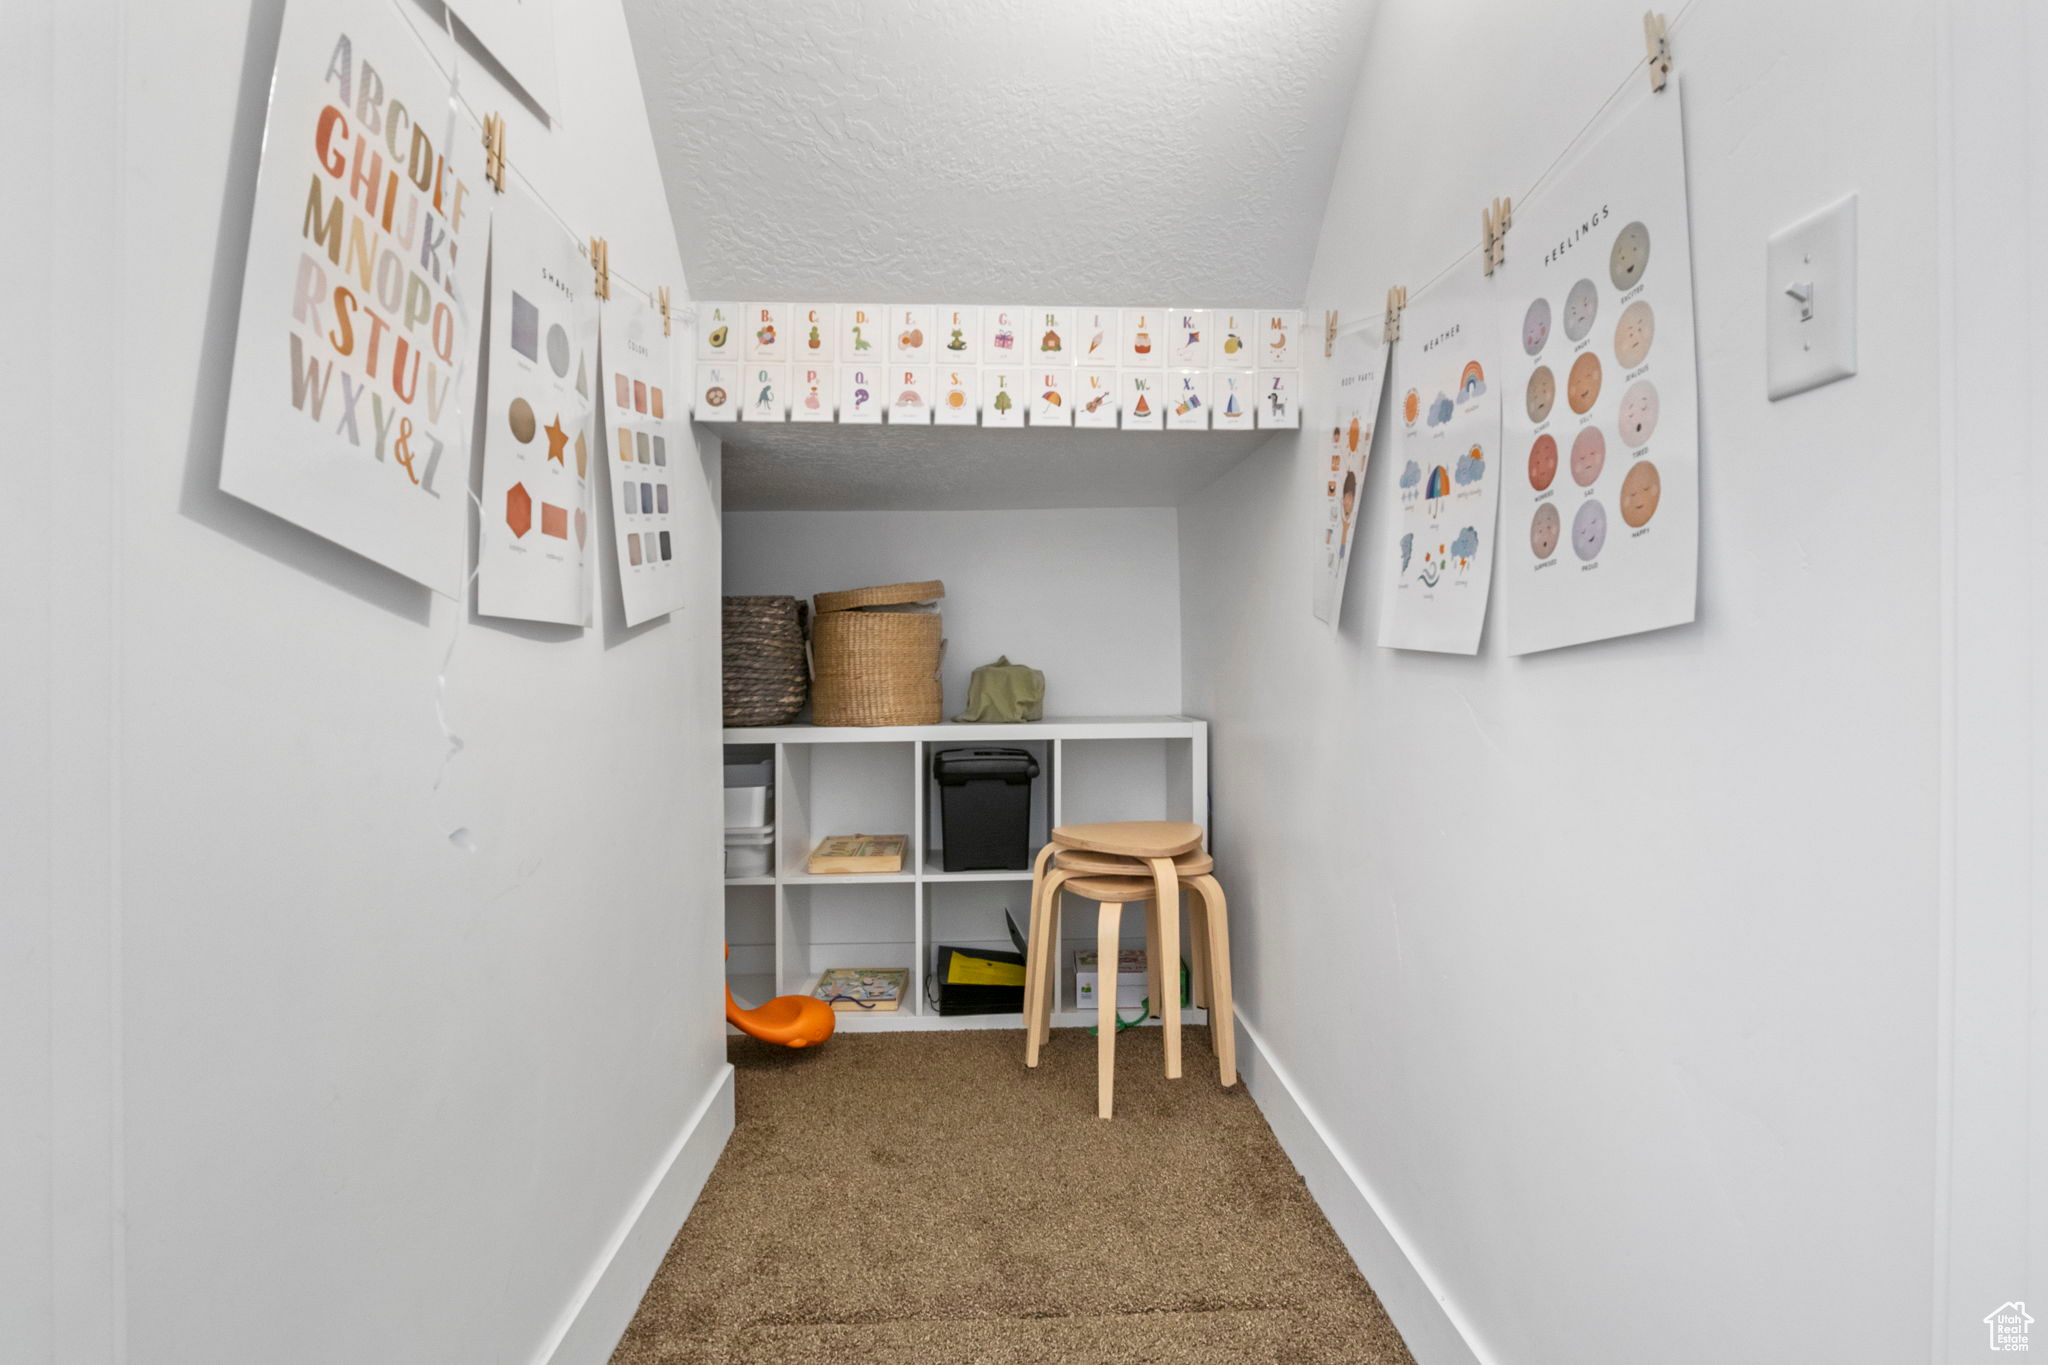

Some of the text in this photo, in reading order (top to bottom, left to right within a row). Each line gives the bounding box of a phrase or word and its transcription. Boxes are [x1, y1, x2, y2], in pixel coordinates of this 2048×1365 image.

[1545, 204, 1609, 267] FEELINGS
[542, 267, 573, 303] SHAPES
[627, 338, 648, 358] COLORS
[1424, 324, 1460, 353] WEATHER
